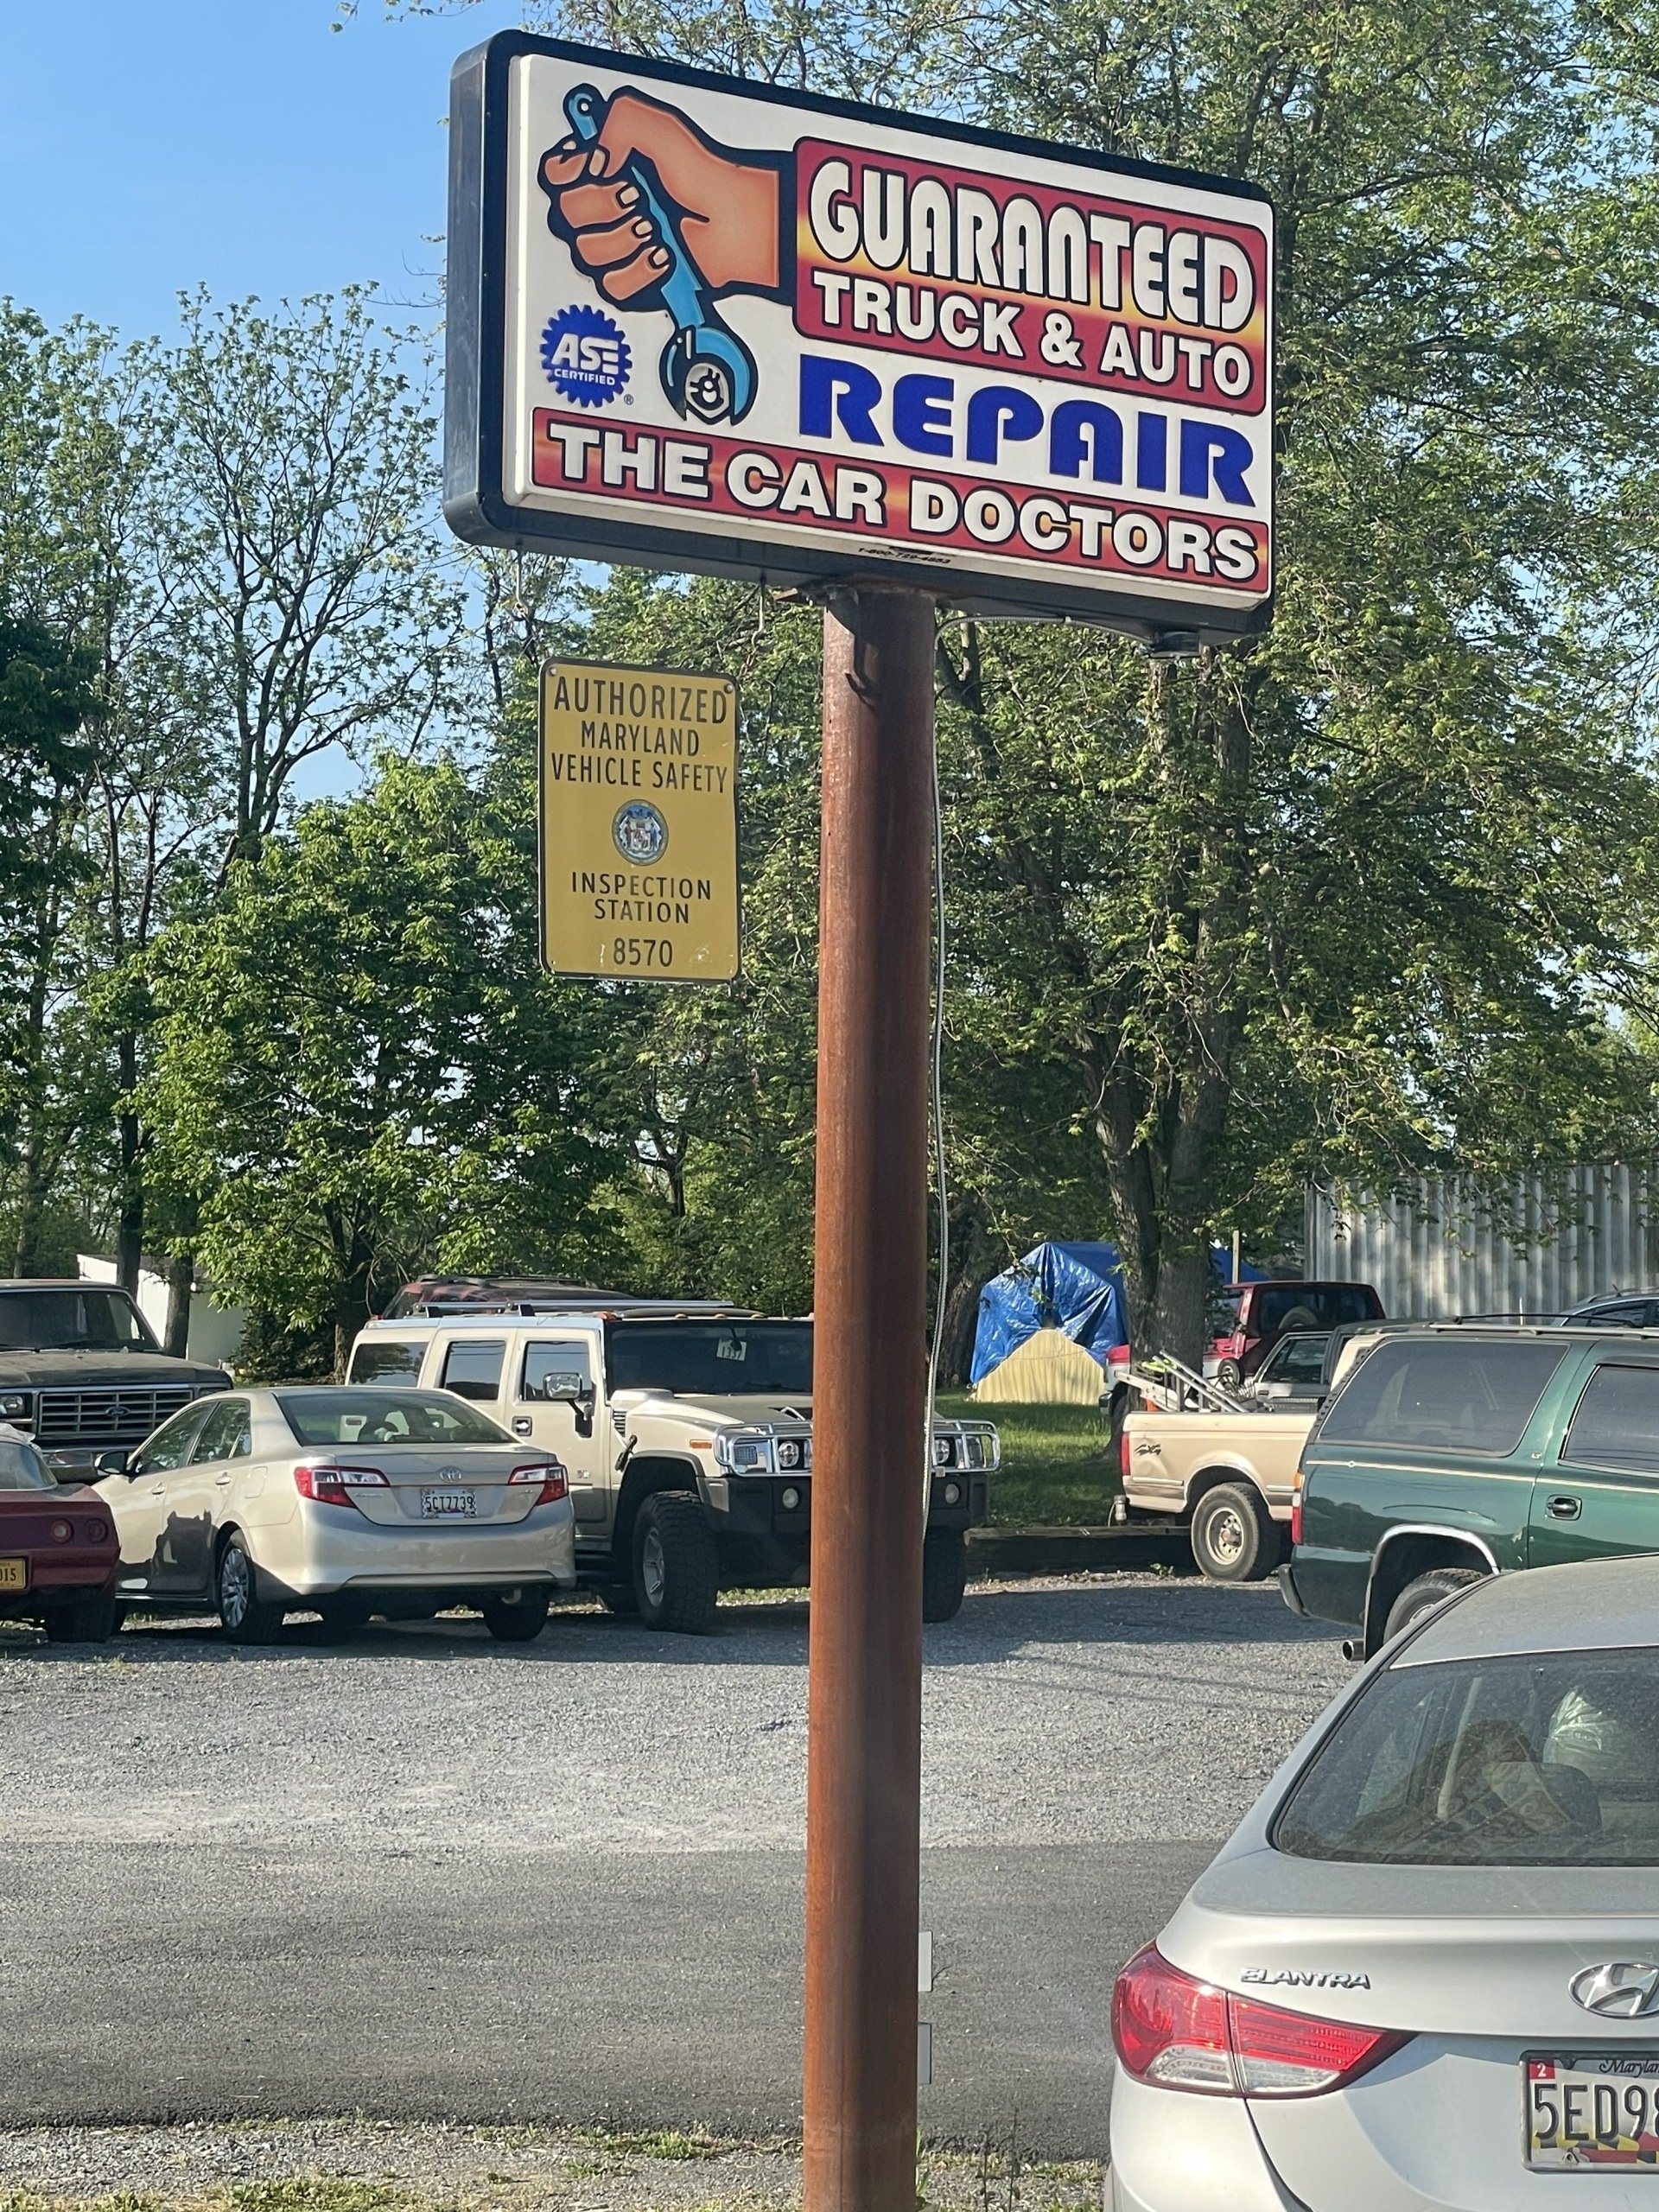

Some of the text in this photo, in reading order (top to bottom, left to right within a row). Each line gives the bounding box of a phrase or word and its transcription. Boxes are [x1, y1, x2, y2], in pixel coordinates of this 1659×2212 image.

[810, 160, 1254, 331] GUARANTEED
[813, 270, 1251, 397] TRUCK & AUTO
[551, 333, 619, 375] ASE
[554, 368, 616, 386] CERTIFIED
[799, 353, 1256, 508] REPAIR
[549, 422, 1257, 581] THE CAR DOCTORS
[553, 676, 728, 725] AUTHORIZED
[581, 720, 700, 757] MARYLAND
[551, 753, 728, 793] VEHICLE SAFETY
[571, 871, 712, 900] INSPECTION
[594, 898, 690, 924] STATION
[613, 938, 673, 967] 8570
[425, 1496, 474, 1511] 5CT7739
[1241, 1967, 1371, 1990] ELANTRA
[1536, 2063, 1547, 2077] 2
[1533, 2083, 1659, 2141] 5ED9
